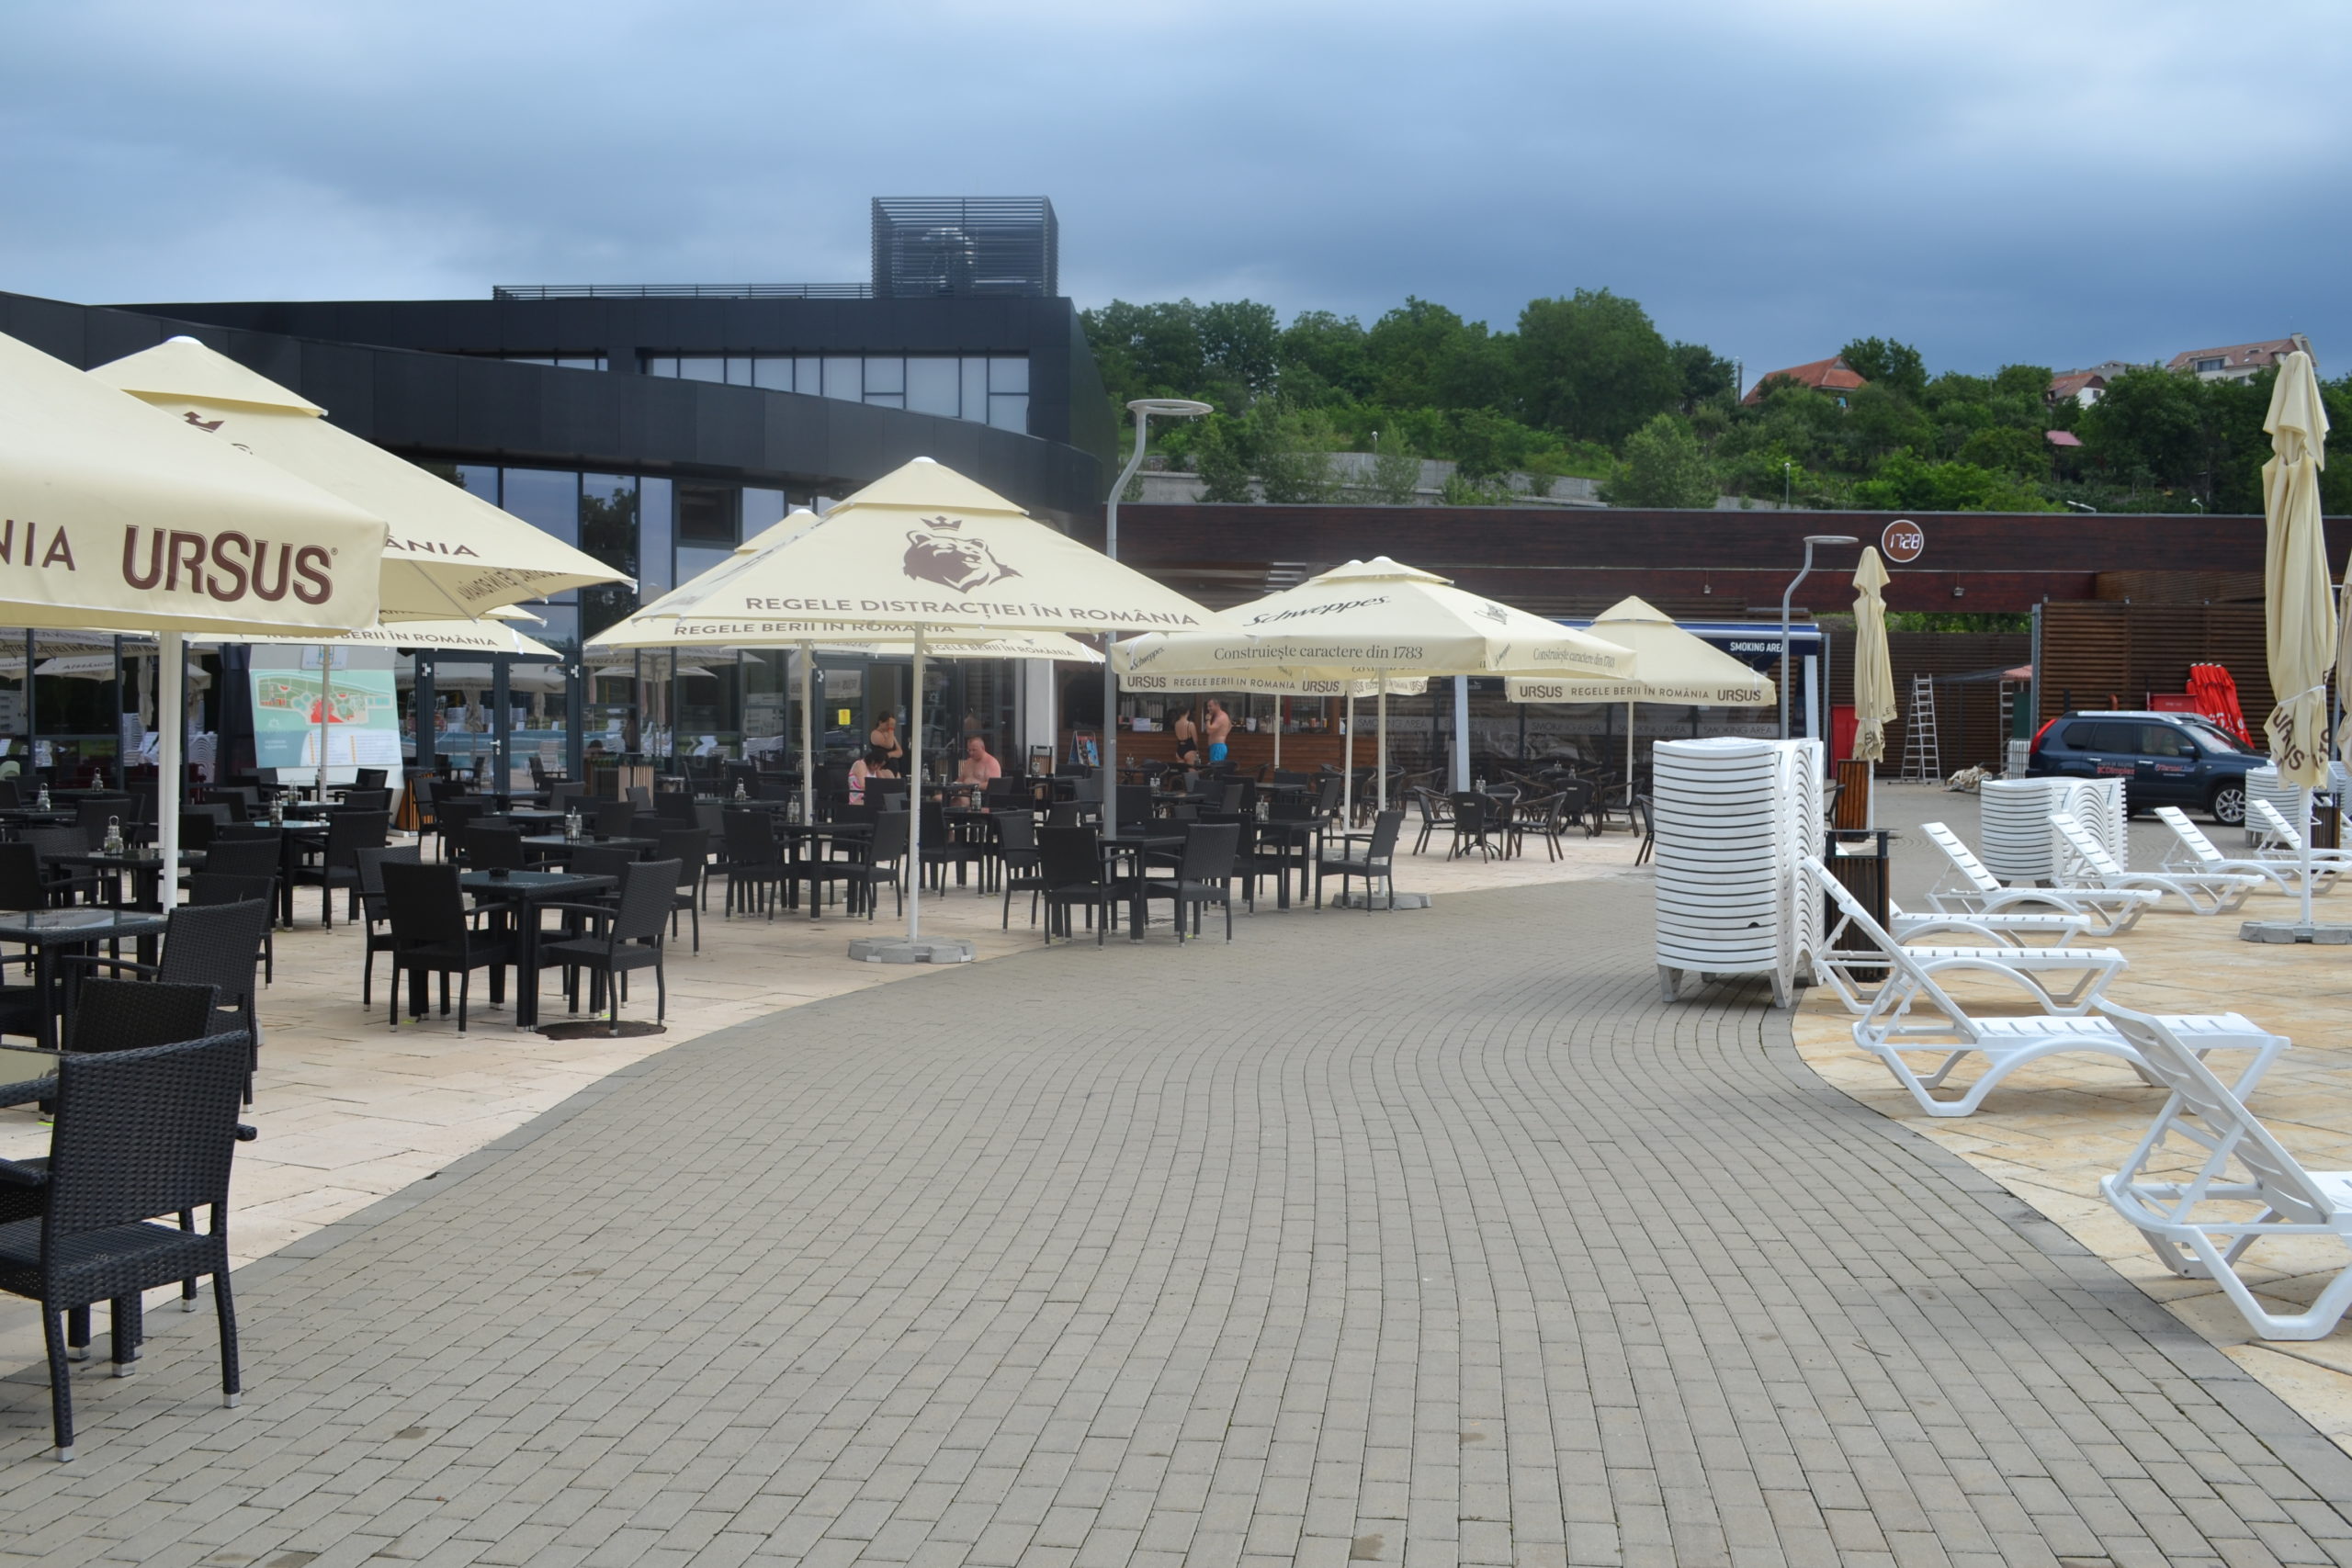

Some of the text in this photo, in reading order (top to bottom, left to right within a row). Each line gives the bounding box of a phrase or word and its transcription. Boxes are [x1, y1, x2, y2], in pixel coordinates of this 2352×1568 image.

[385, 535, 481, 558] ÂNIA
[122, 524, 334, 605] URSUS
[746, 598, 853, 611] REGELE
[1069, 607, 1200, 626] ROMÂNIA
[1243, 595, 1389, 627] Schweppes
[674, 624, 754, 635] REGELE
[762, 622, 815, 633] BERII
[414, 634, 499, 647] ROMÂNIA
[1730, 641, 1765, 652] SMOKING
[1299, 646, 1363, 659] caractere
[1366, 645, 1389, 659] din
[1394, 646, 1423, 660] 1783
[1127, 675, 1167, 688] URSUS
[1174, 677, 1207, 687] REGELE
[1210, 676, 1234, 686] BERII
[1302, 680, 1340, 693] URSUS
[1520, 685, 1563, 699] URSUS
[1571, 687, 1610, 696] REGELE
[1613, 686, 1641, 695] BERII
[1659, 687, 1709, 699] ROMÂNIA
[1717, 688, 1761, 702] URSUS
[1358, 718, 1401, 728] SMONG
